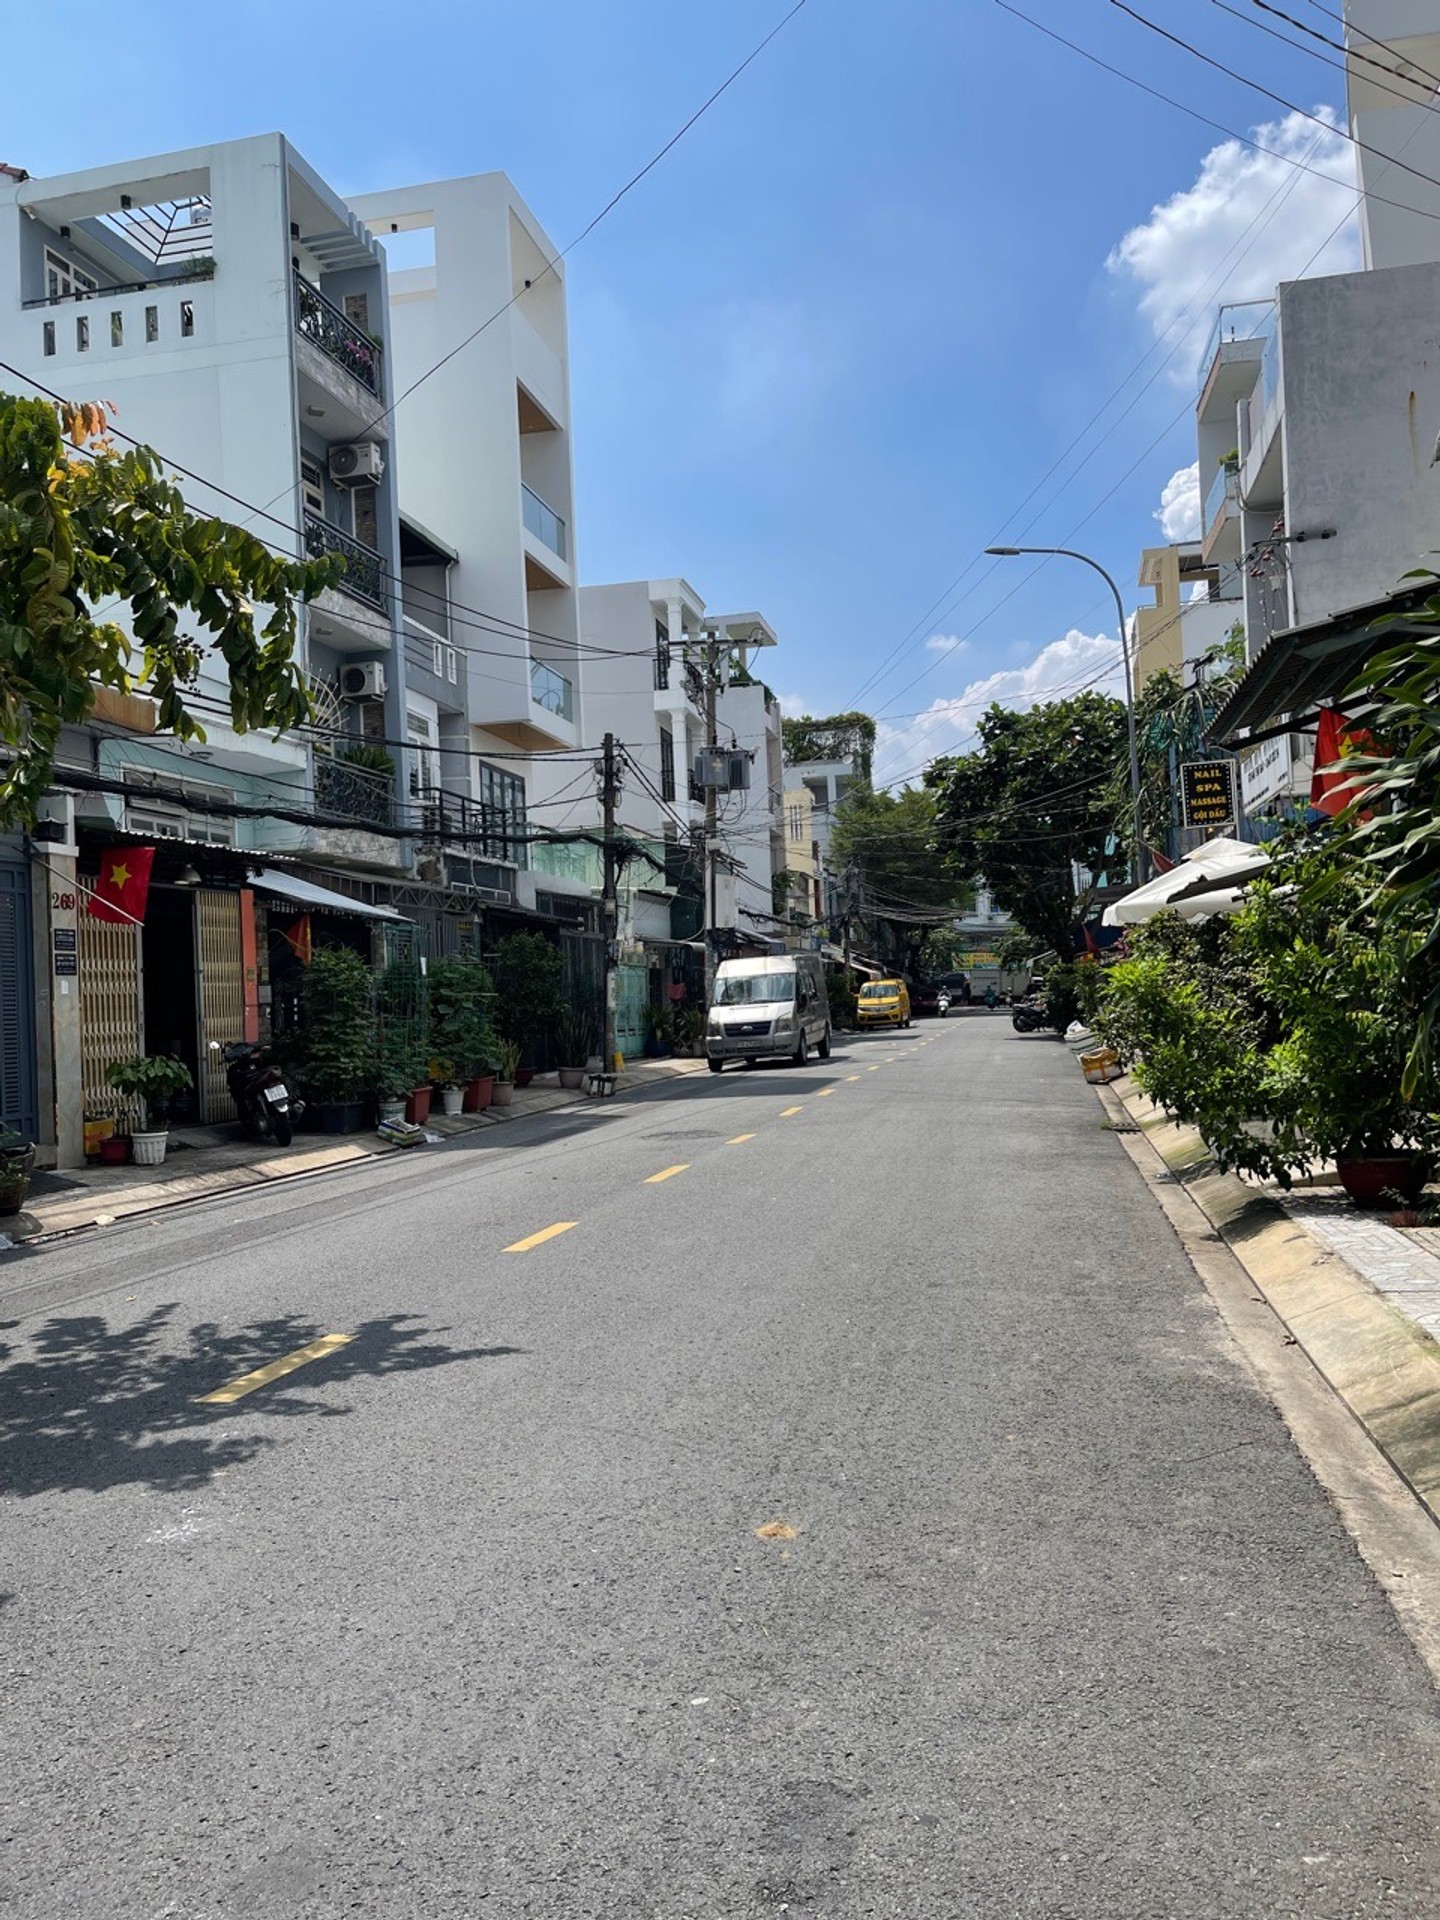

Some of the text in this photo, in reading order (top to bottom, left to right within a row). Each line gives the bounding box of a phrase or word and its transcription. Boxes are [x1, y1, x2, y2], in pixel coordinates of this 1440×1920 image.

[1193, 769, 1222, 779] NAIL
[1195, 783, 1222, 793] SPA
[1190, 795, 1227, 807] MASSAGE
[52, 892, 75, 910] 269
